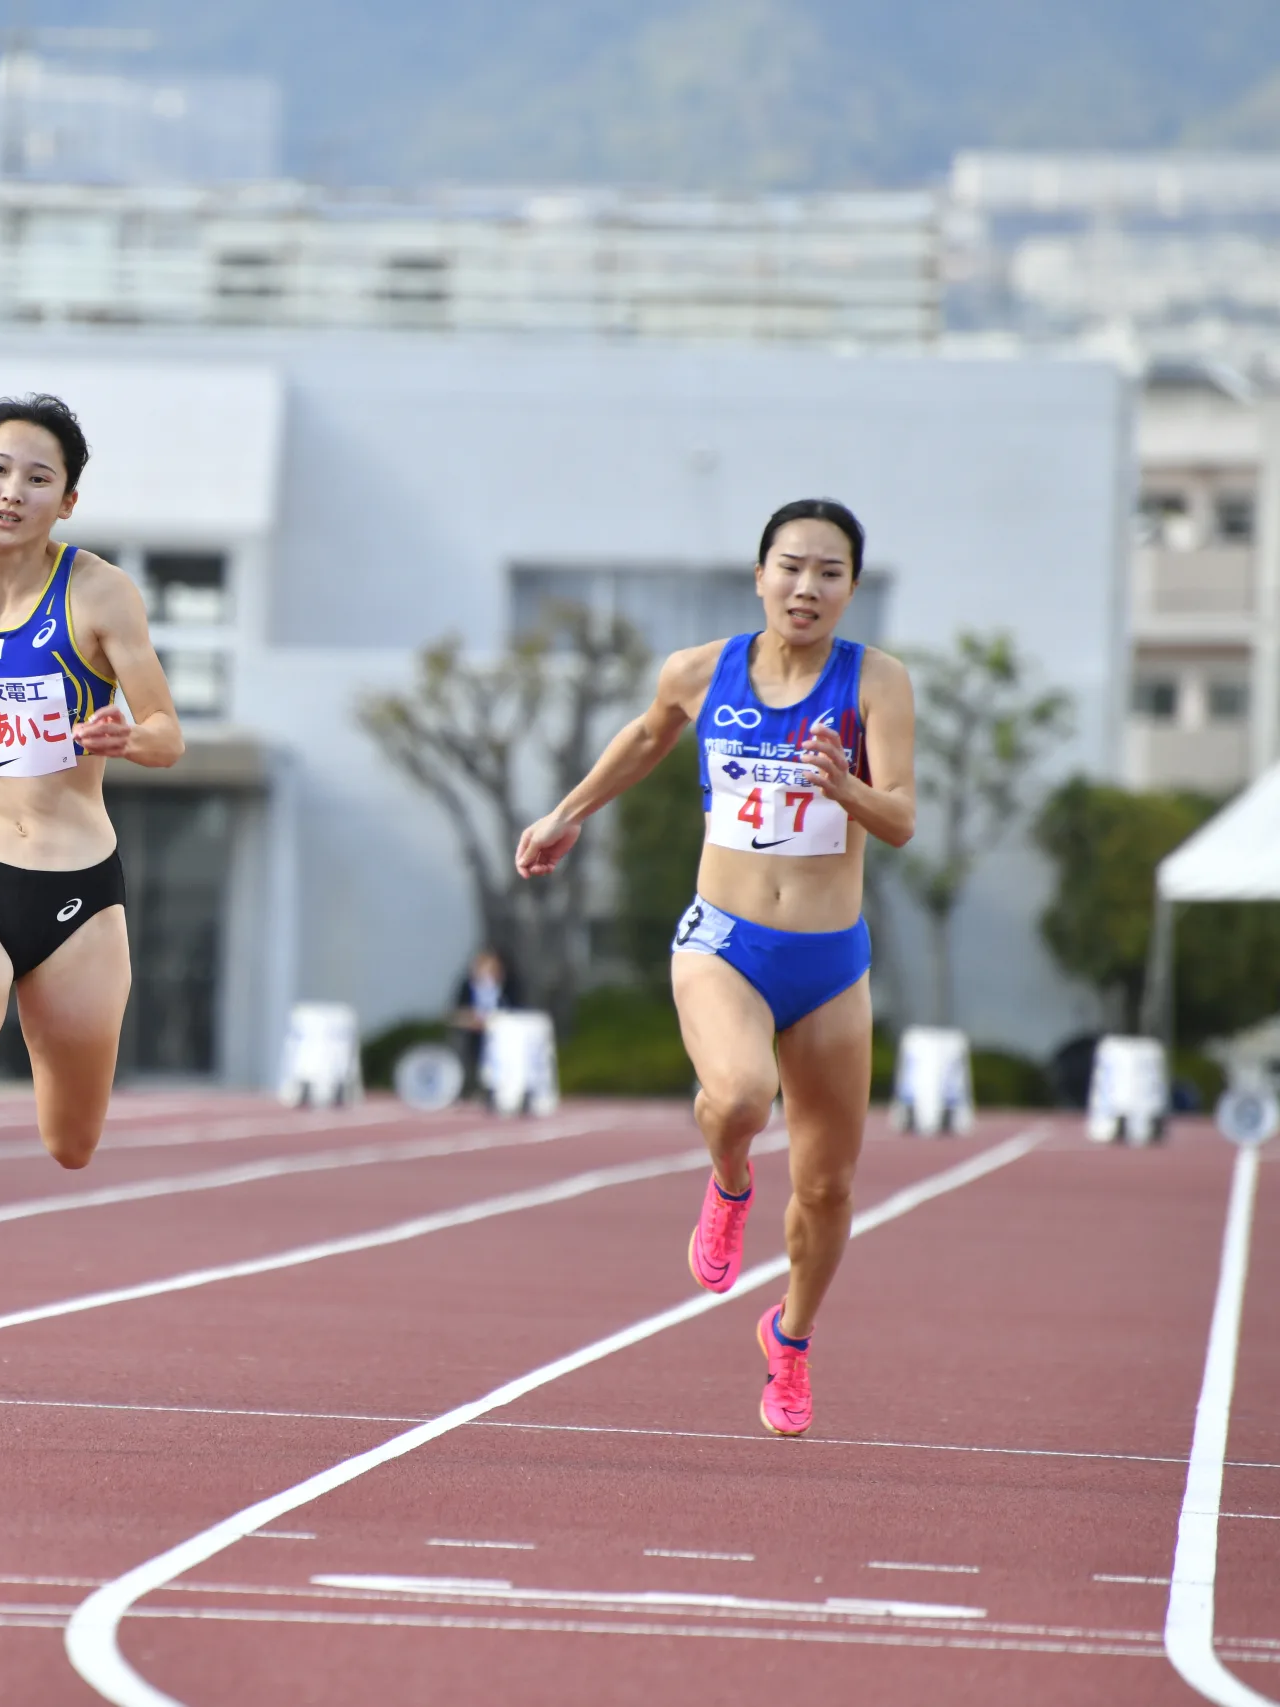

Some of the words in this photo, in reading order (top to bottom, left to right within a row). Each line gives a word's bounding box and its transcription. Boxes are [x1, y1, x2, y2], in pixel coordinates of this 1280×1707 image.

[752, 763, 818, 787] 住友電
[738, 787, 814, 832] 47
